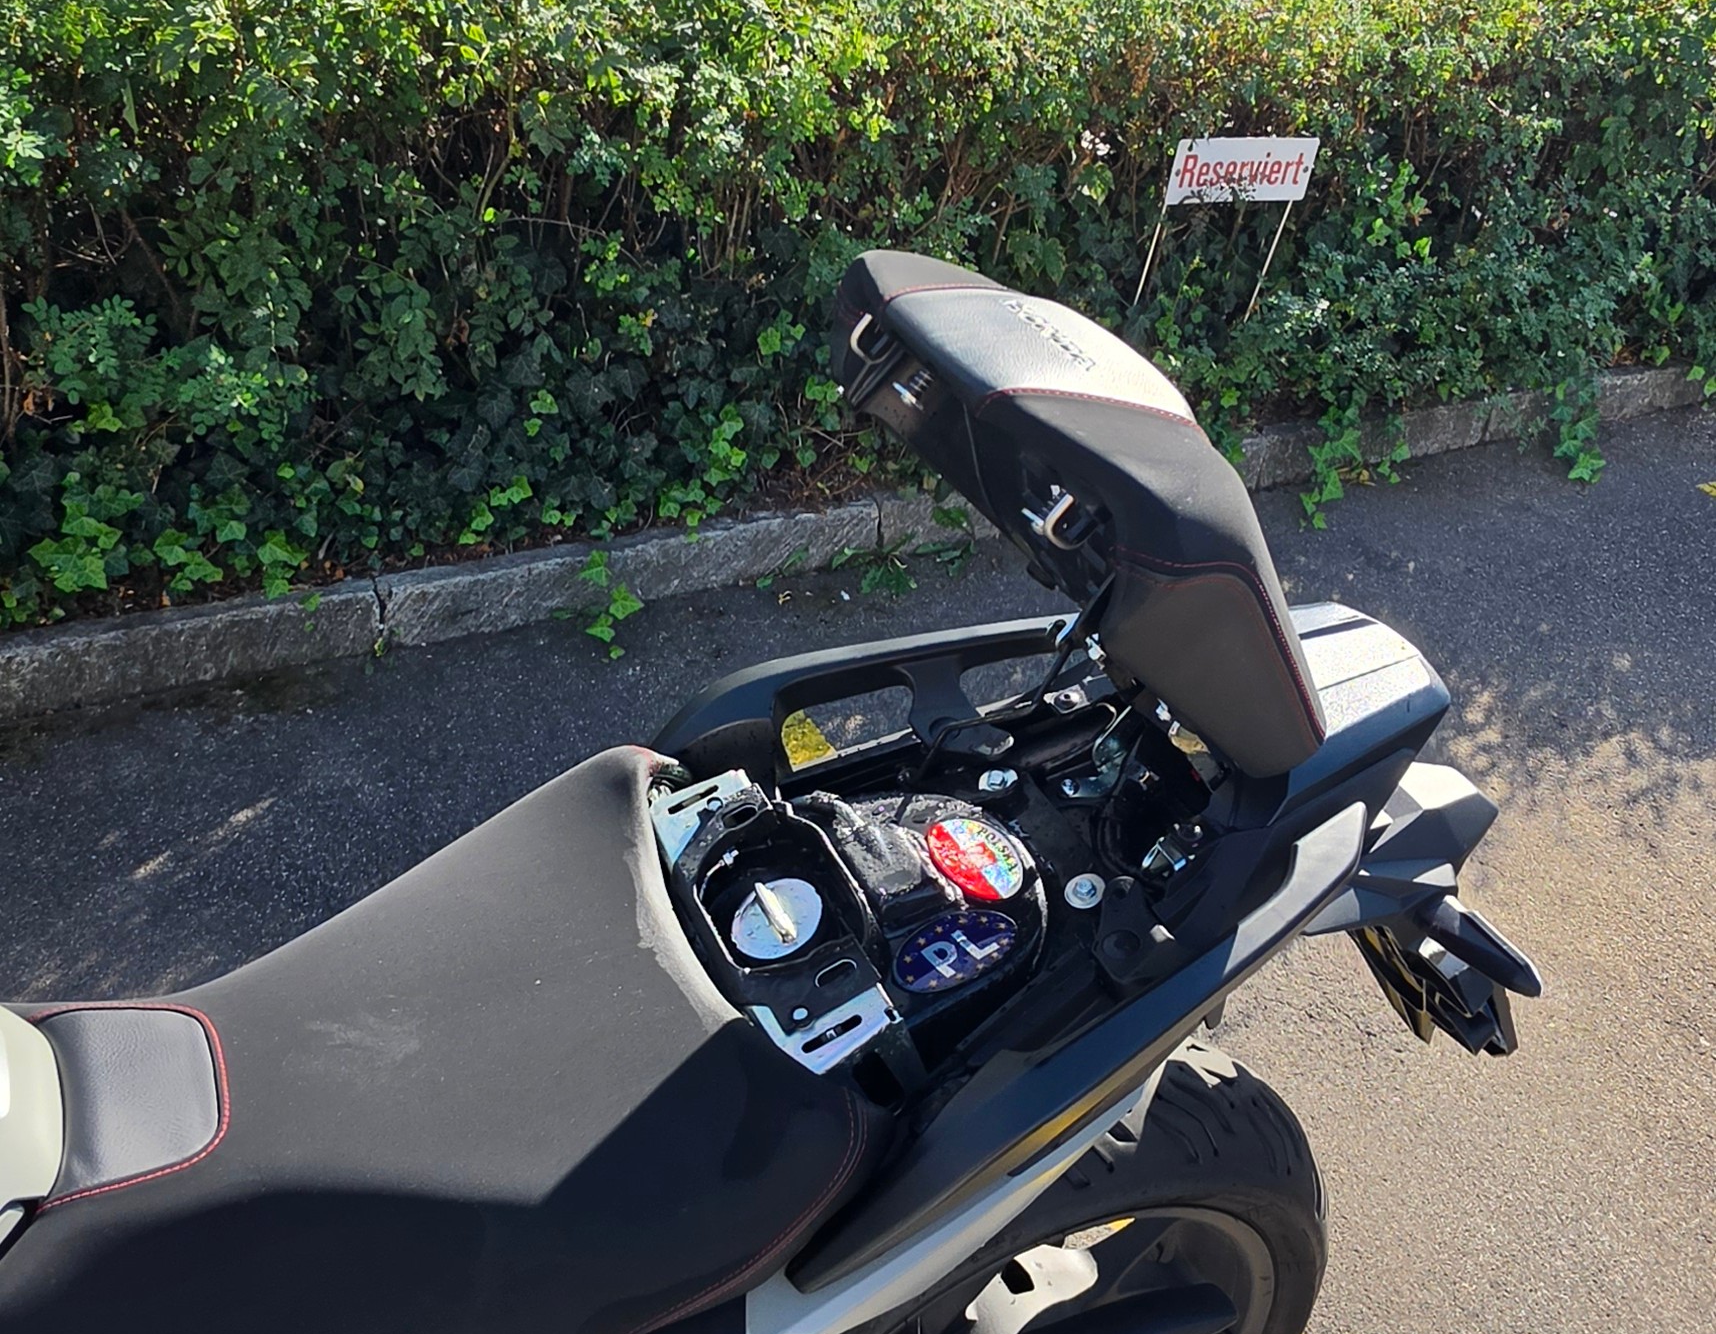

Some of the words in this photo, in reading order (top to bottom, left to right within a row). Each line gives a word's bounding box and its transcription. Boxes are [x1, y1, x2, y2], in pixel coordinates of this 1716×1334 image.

[1178, 152, 1304, 188] Reserviert
[976, 825, 1018, 873] POLSKA
[921, 929, 1000, 978] PL
